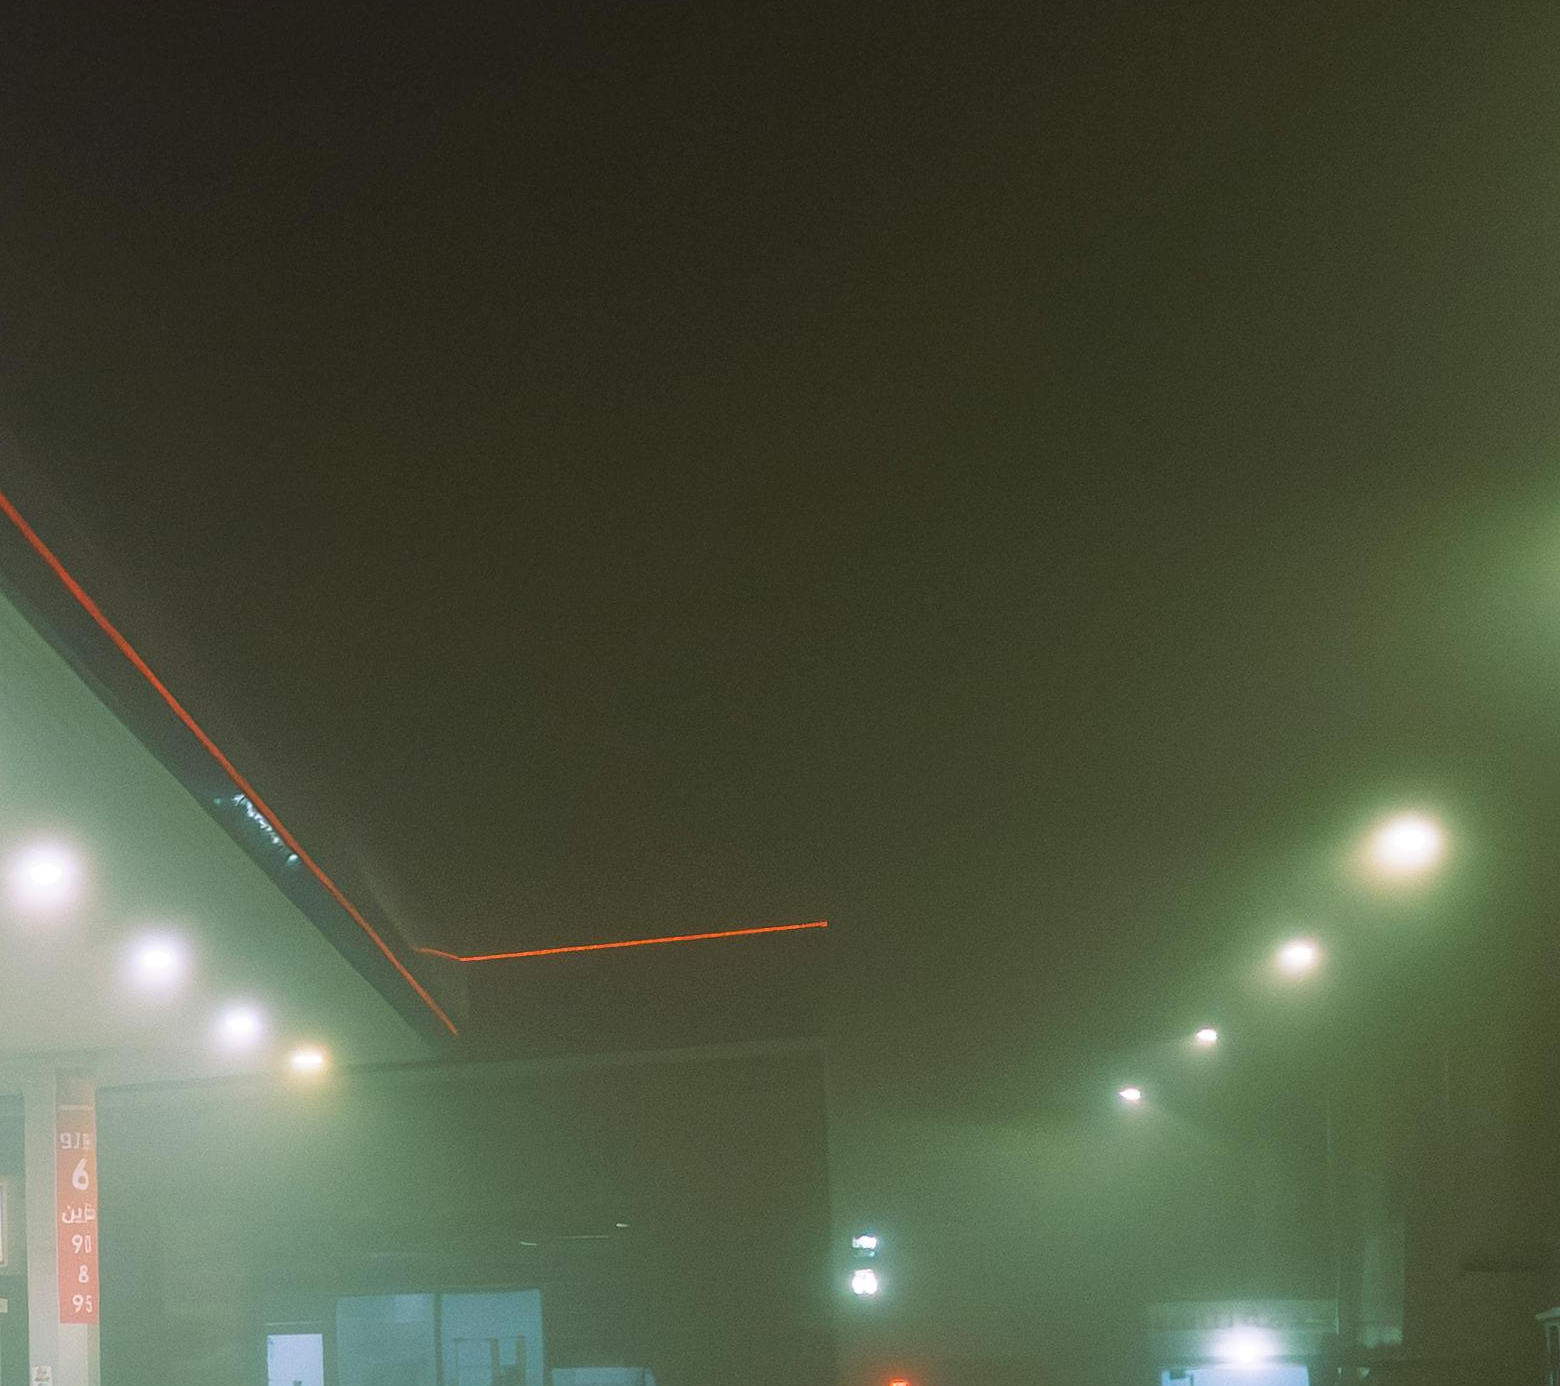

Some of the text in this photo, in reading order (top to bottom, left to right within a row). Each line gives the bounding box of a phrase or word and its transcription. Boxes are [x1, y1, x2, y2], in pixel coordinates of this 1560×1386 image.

[72, 1158, 89, 1190] 6
[72, 1234, 91, 1254] 90
[72, 1294, 92, 1313] 95
